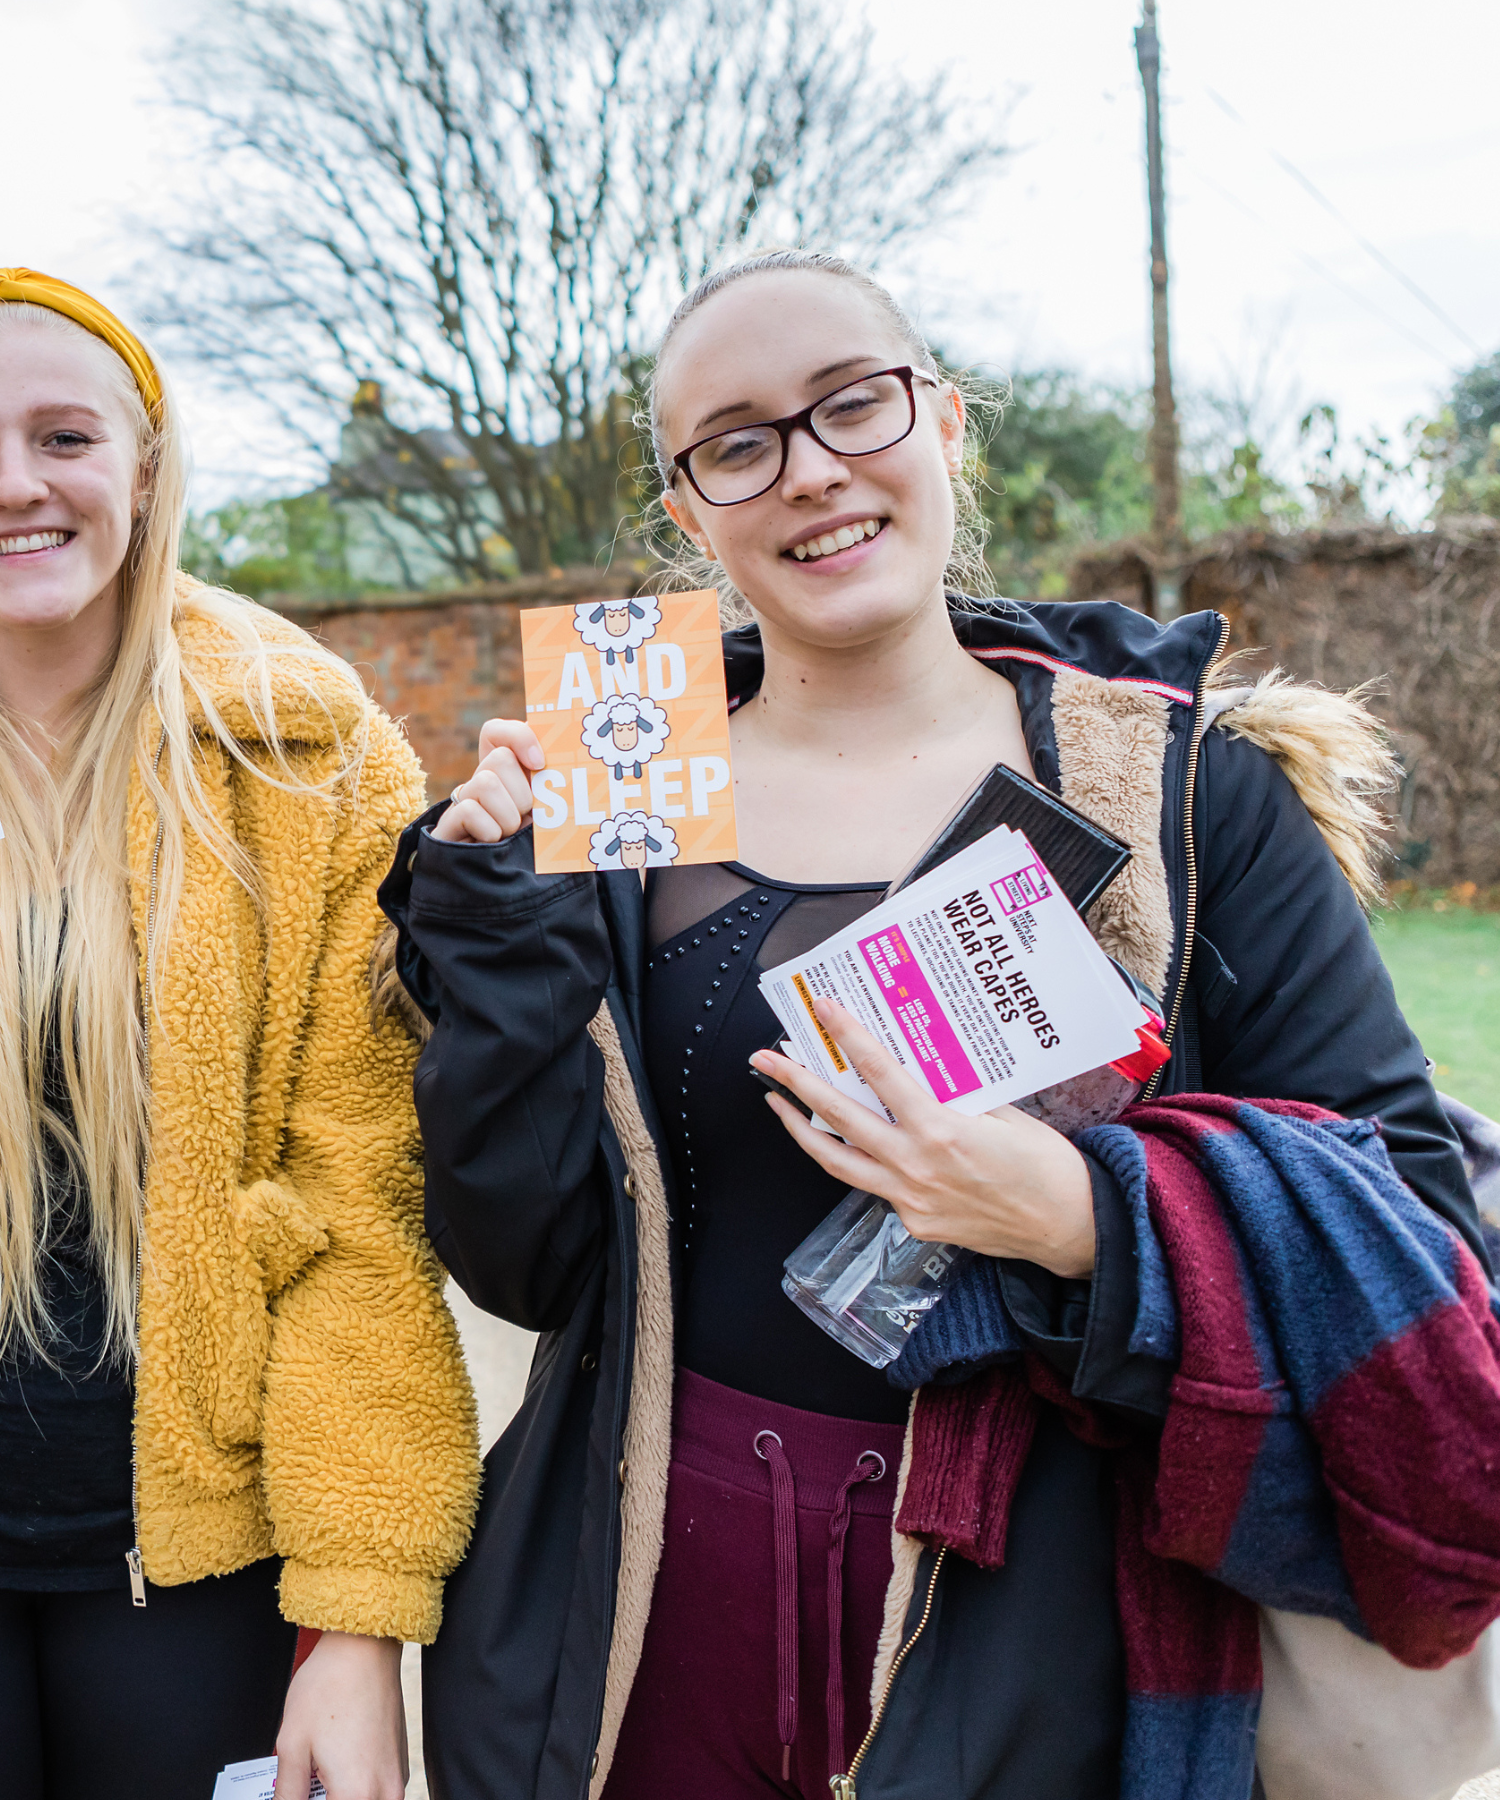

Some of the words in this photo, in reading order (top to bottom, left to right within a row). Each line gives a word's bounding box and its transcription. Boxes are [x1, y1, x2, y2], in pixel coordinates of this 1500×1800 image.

[531, 756, 730, 829] SLEEP
[1005, 882, 1022, 903] STREETS
[1020, 879, 1032, 895] LIVING
[1010, 917, 1033, 953] UNIVERSITY
[1014, 914, 1031, 934] STEPS
[1024, 935, 1036, 944] AT
[1024, 910, 1037, 926] NEXT
[866, 941, 895, 988] WALKING
[878, 936, 900, 967] MORE
[896, 942, 910, 962] SIMPLE
[943, 898, 982, 956] WEAR
[974, 960, 1019, 1022] CAPES
[962, 890, 996, 928] NOT
[984, 935, 1014, 969] ALL
[1006, 971, 1060, 1048] HEROES
[810, 980, 821, 996] ENTER
[819, 962, 829, 978] WE'RE
[827, 979, 838, 996] LIVING
[923, 914, 937, 938] PHYSICAL
[936, 940, 944, 950] AND
[943, 951, 954, 971] MENTAL
[966, 995, 978, 1013] YOU'RE
[976, 1015, 986, 1027] ONLY
[984, 1029, 995, 1045] GOING
[993, 1047, 1002, 1057] AND
[1000, 1059, 1013, 1078] SAVING
[936, 922, 946, 934] ONLY
[944, 936, 952, 945] ARE
[950, 946, 958, 957] YOU
[956, 958, 968, 977] SAVING
[966, 978, 978, 996] MONEY
[977, 998, 985, 1009] AND
[983, 1010, 1000, 1036] BOOSTING
[998, 1037, 1008, 1051] YOUR
[1007, 1053, 1016, 1065] OWN
[844, 950, 852, 962] YOU
[850, 964, 858, 974] ARE
[861, 984, 887, 1030] ENVIRONMENTAL
[886, 1032, 906, 1065] SUPERSTAR
[850, 996, 858, 1007] even
[905, 1002, 918, 1018] LESS
[913, 999, 926, 1014] LESS
[920, 928, 933, 947] PLANET
[938, 962, 950, 980] YOU'RE
[948, 981, 960, 998] DOING
[961, 1005, 972, 1021] EVERY
[976, 1036, 987, 1047] JUST
[989, 1057, 1004, 1080] WALKING
[926, 957, 945, 989] SOCIALISING
[943, 990, 950, 998] OR
[948, 999, 960, 1017] TAKING
[961, 1023, 972, 1040] BREAK
[970, 1042, 982, 1056] FROM
[812, 967, 820, 977] JOIN
[818, 978, 826, 989] OUR
[884, 1107, 896, 1123] INBOX
[900, 1011, 918, 1038] HAPPIER
[914, 1038, 931, 1062] PLANET
[910, 1018, 939, 1058] PARTICULATE
[935, 1059, 957, 1092] POLLUTION
